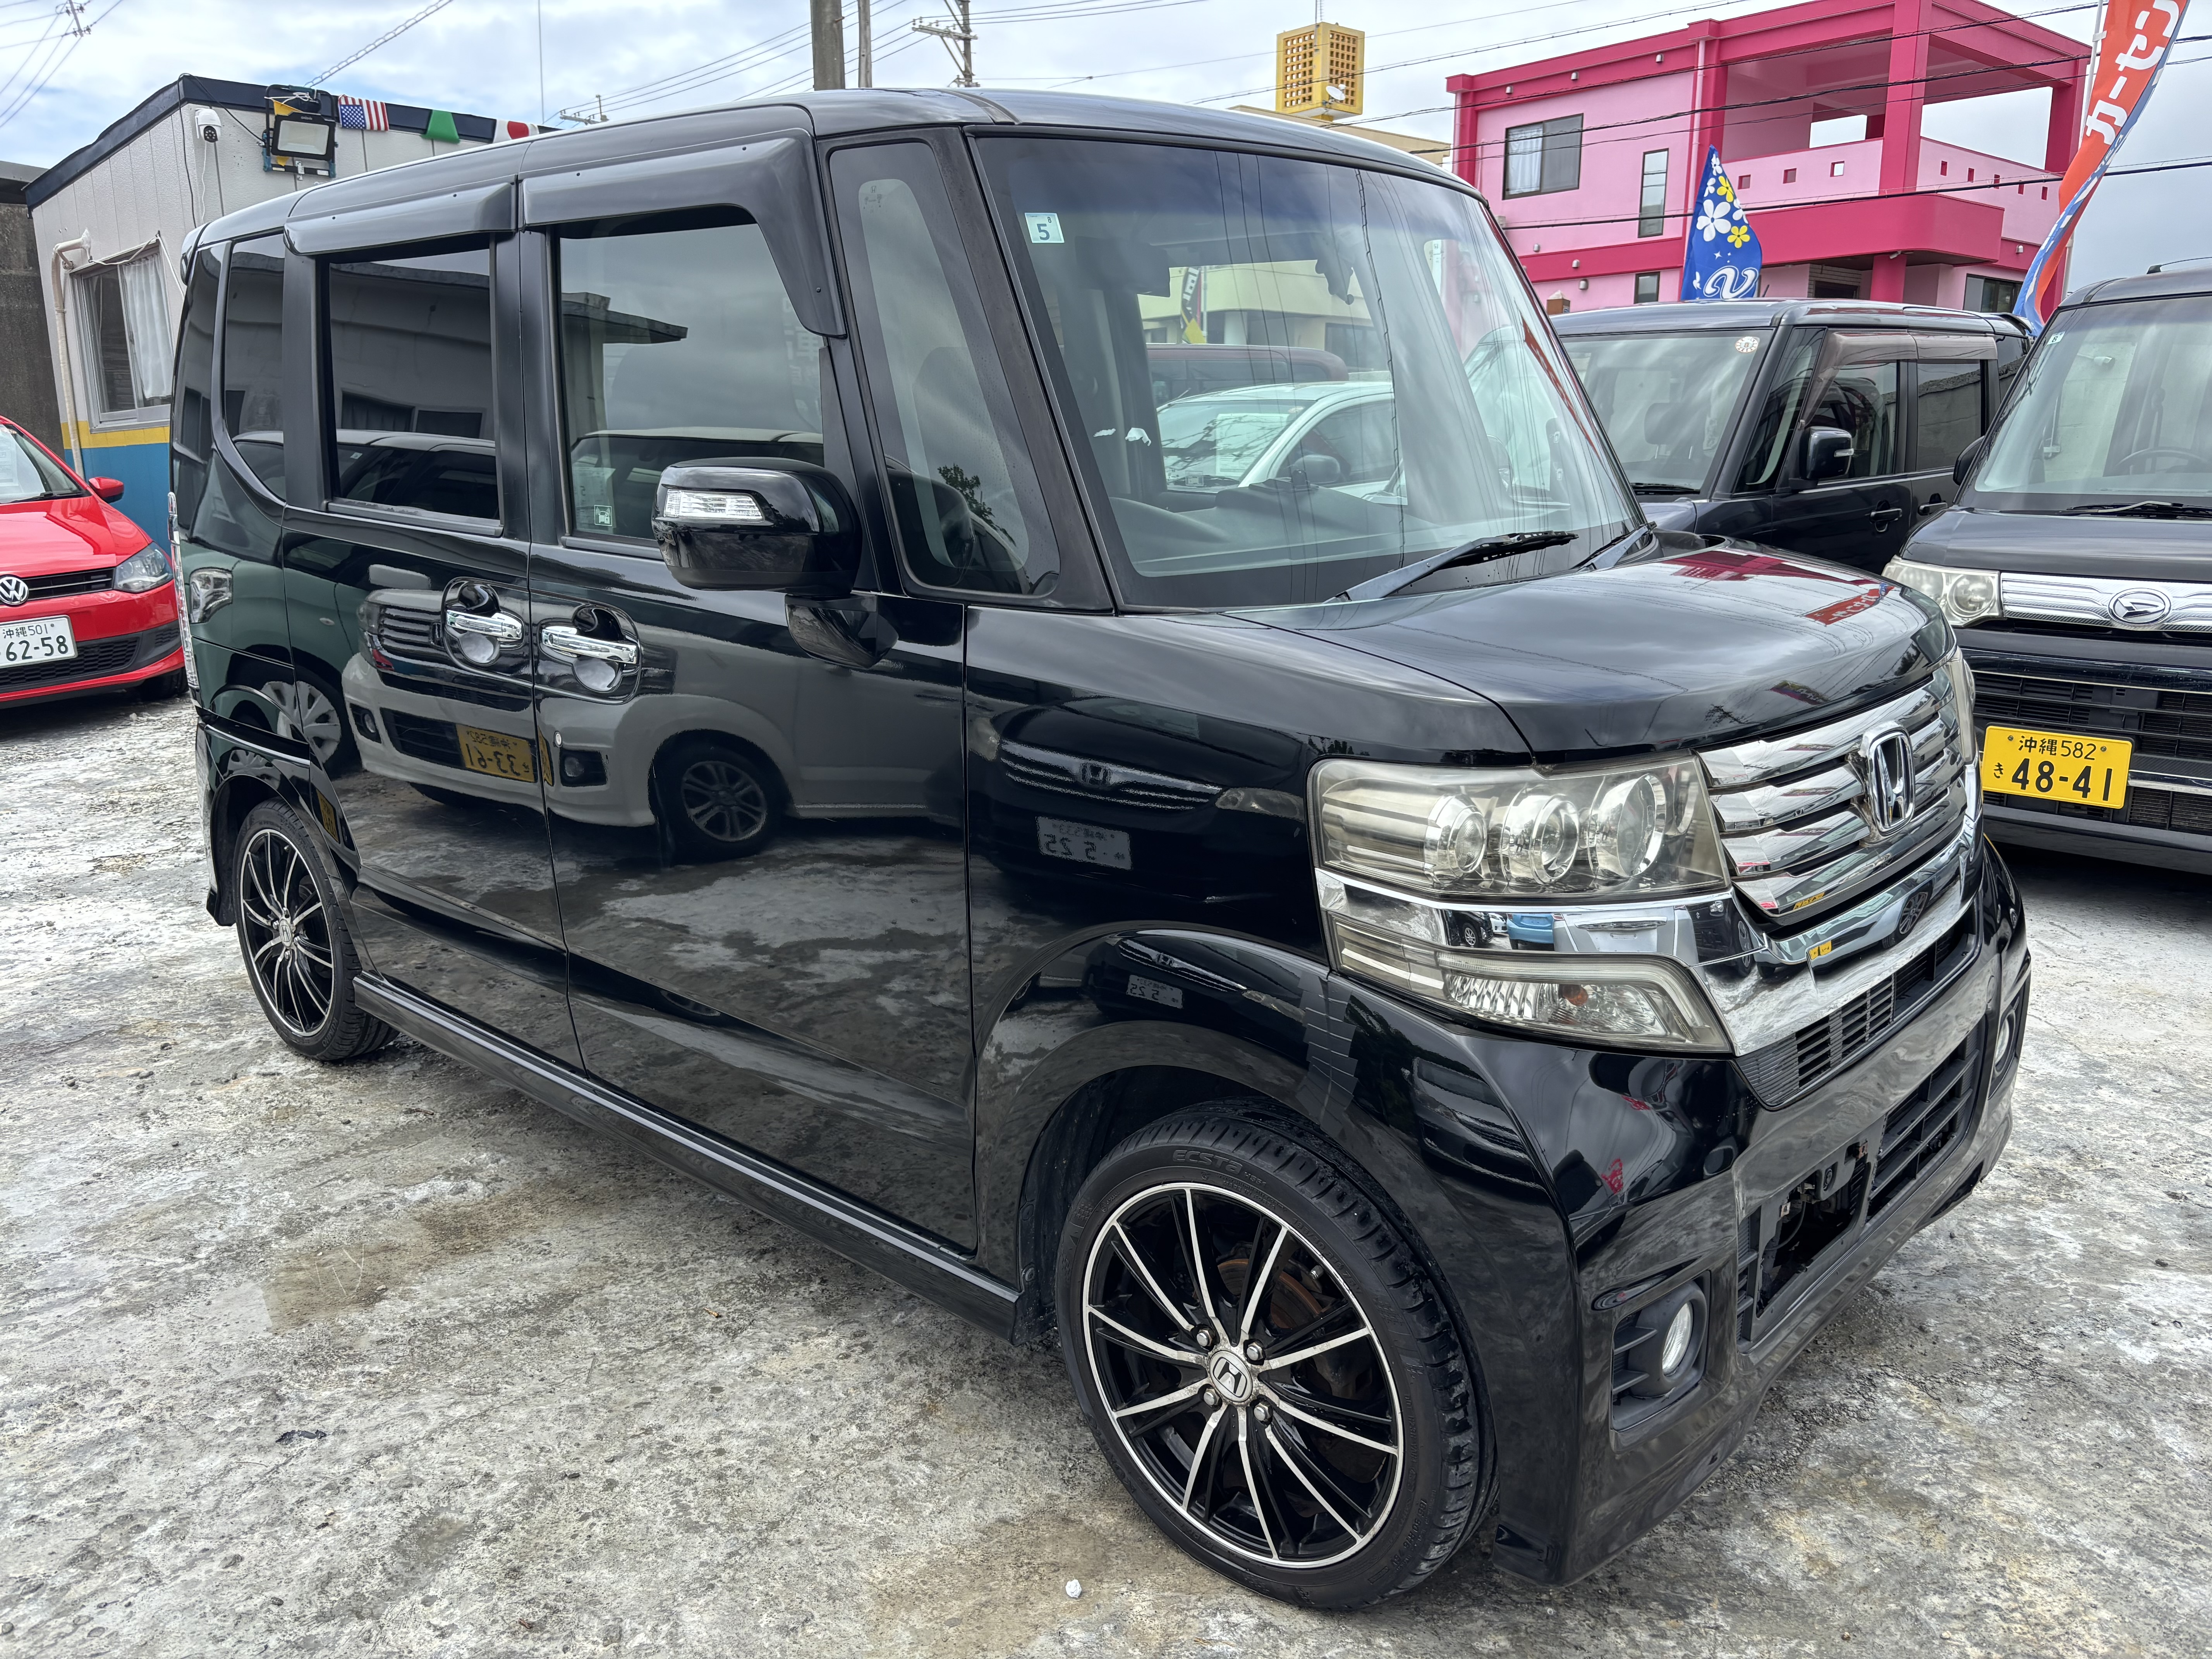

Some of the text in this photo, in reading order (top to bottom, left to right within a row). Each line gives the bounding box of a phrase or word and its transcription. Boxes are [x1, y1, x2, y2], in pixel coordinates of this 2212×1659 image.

[1037, 223, 1050, 240] 5
[3, 624, 48, 639] 沖縄501
[6, 635, 69, 661] 62-58
[2018, 736, 2097, 760] 沖縄582
[1993, 758, 2112, 801] き 48-41
